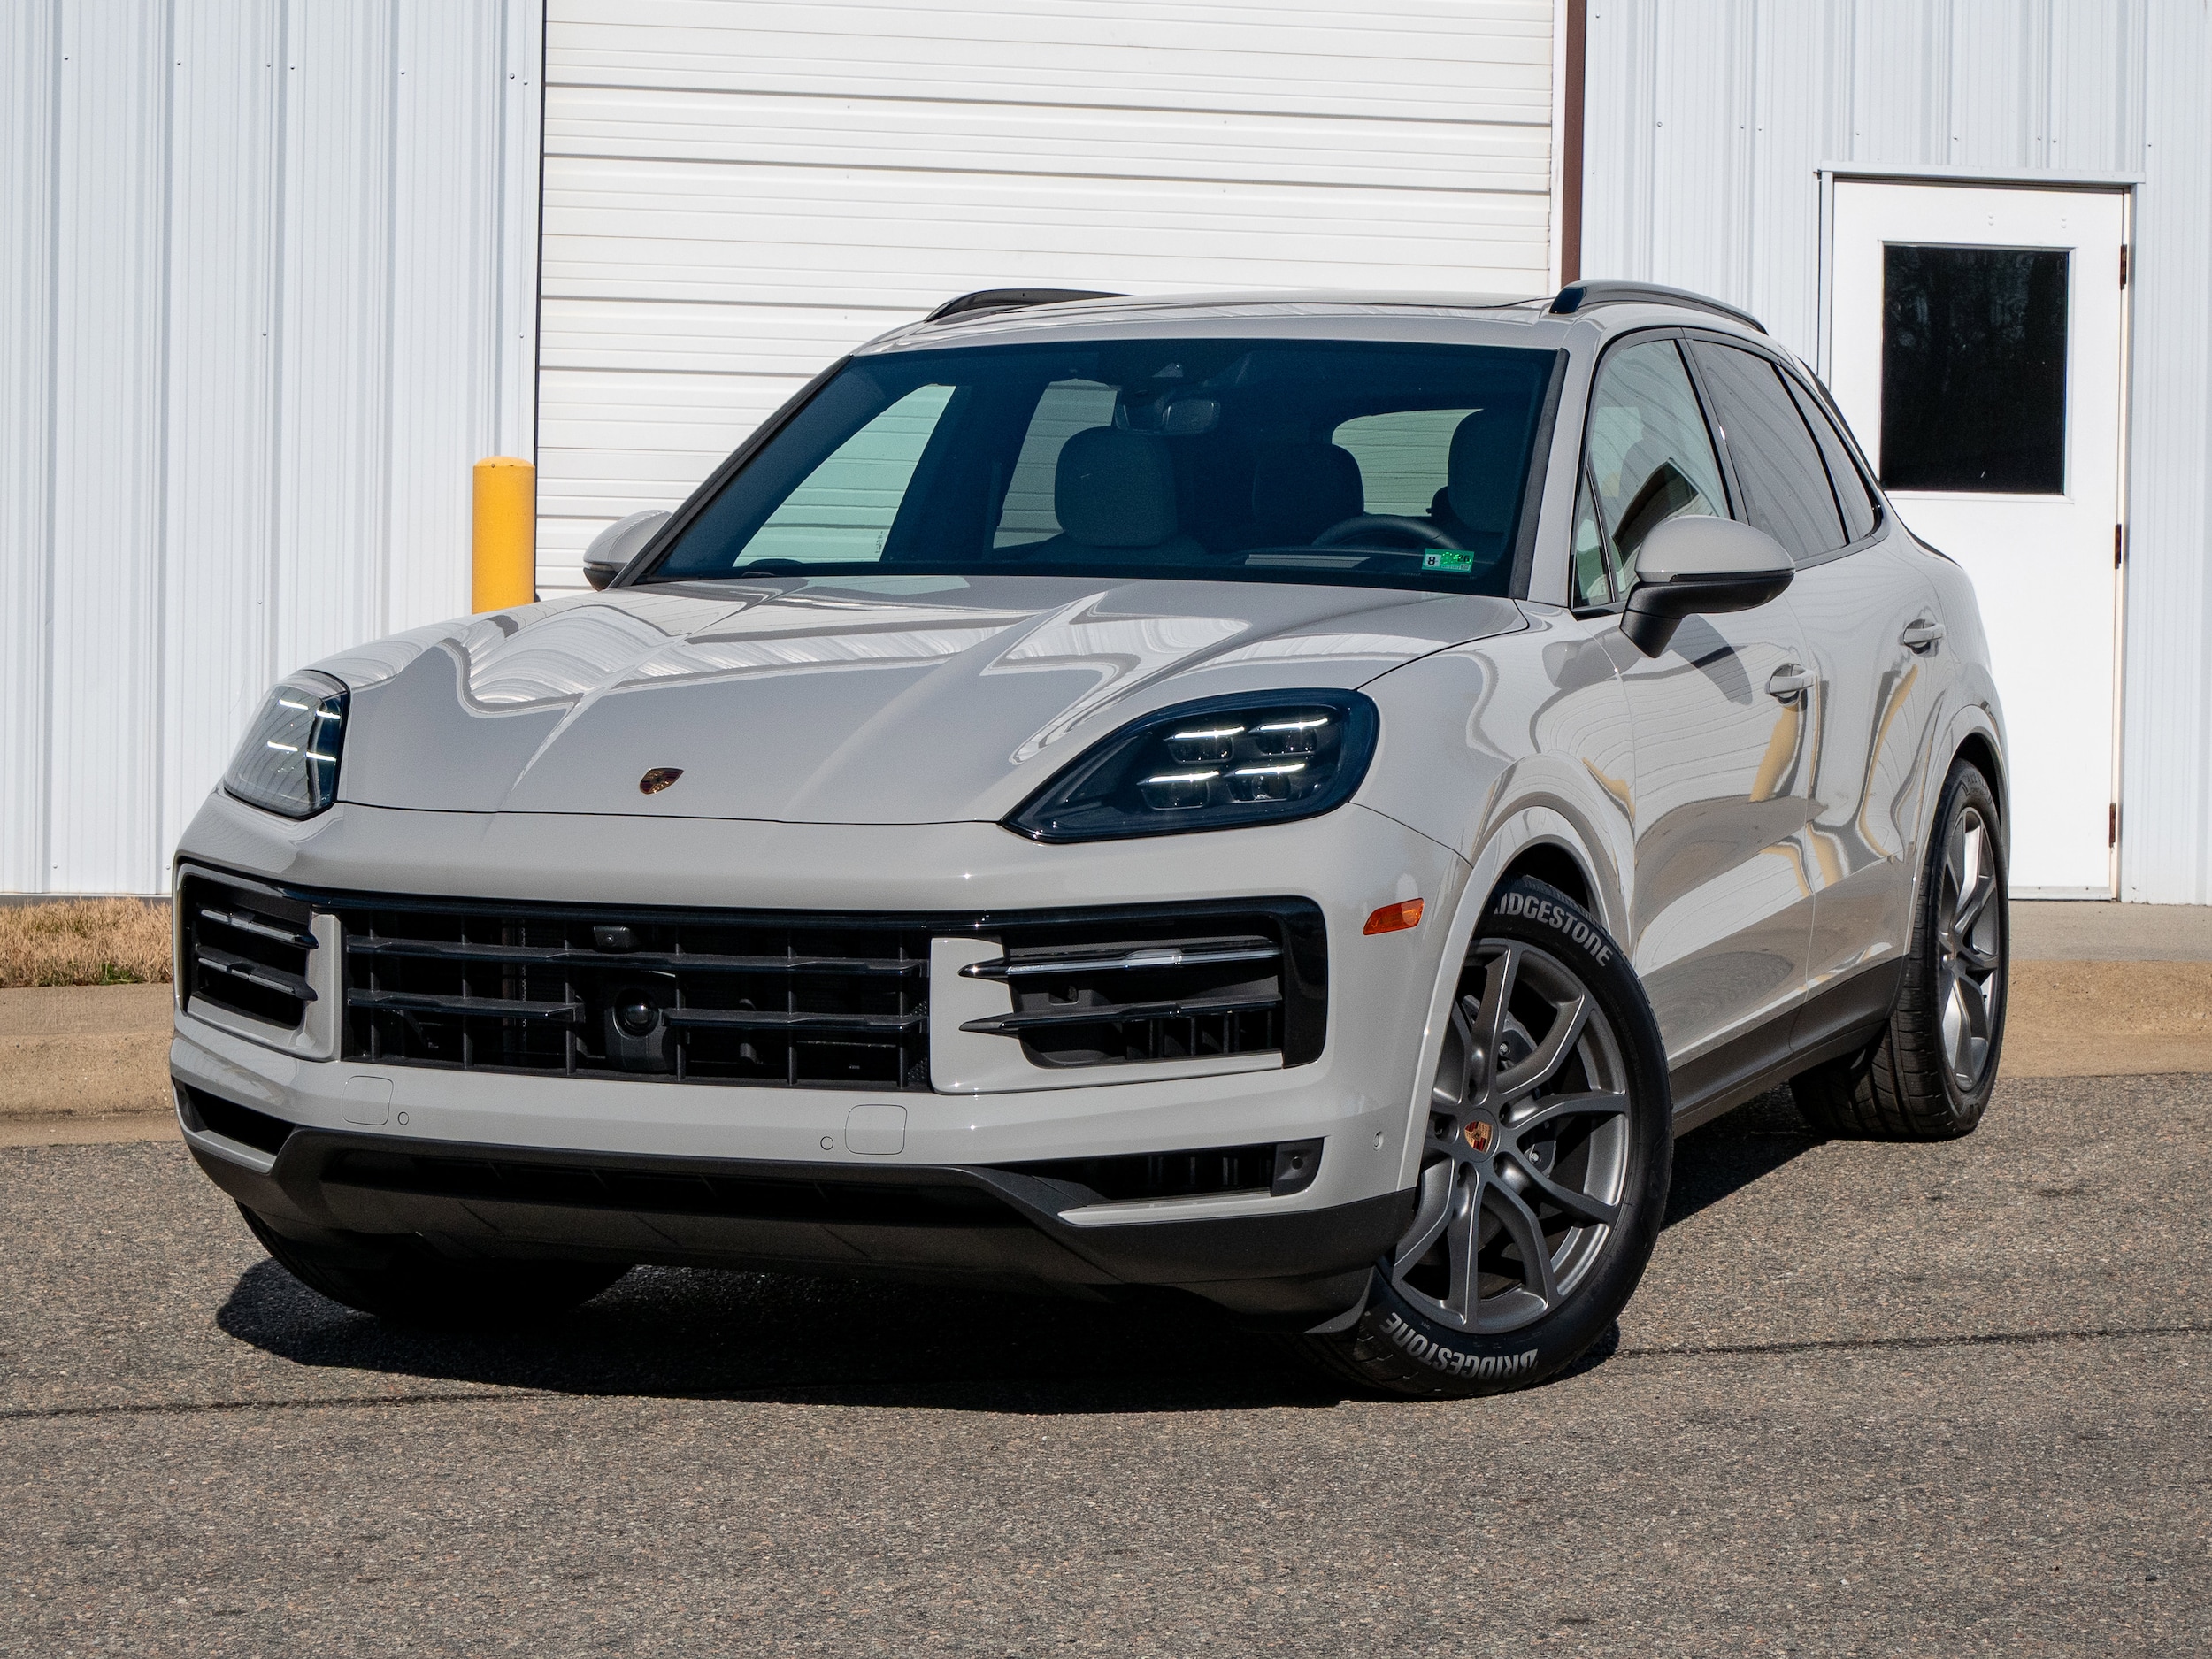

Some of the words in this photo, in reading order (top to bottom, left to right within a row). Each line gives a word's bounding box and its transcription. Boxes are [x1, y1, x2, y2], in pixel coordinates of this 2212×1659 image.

[1427, 556, 1436, 565] 8
[1494, 892, 1614, 967] IDGESTONE
[1379, 1311, 1539, 1380] BRIDGESTONE
